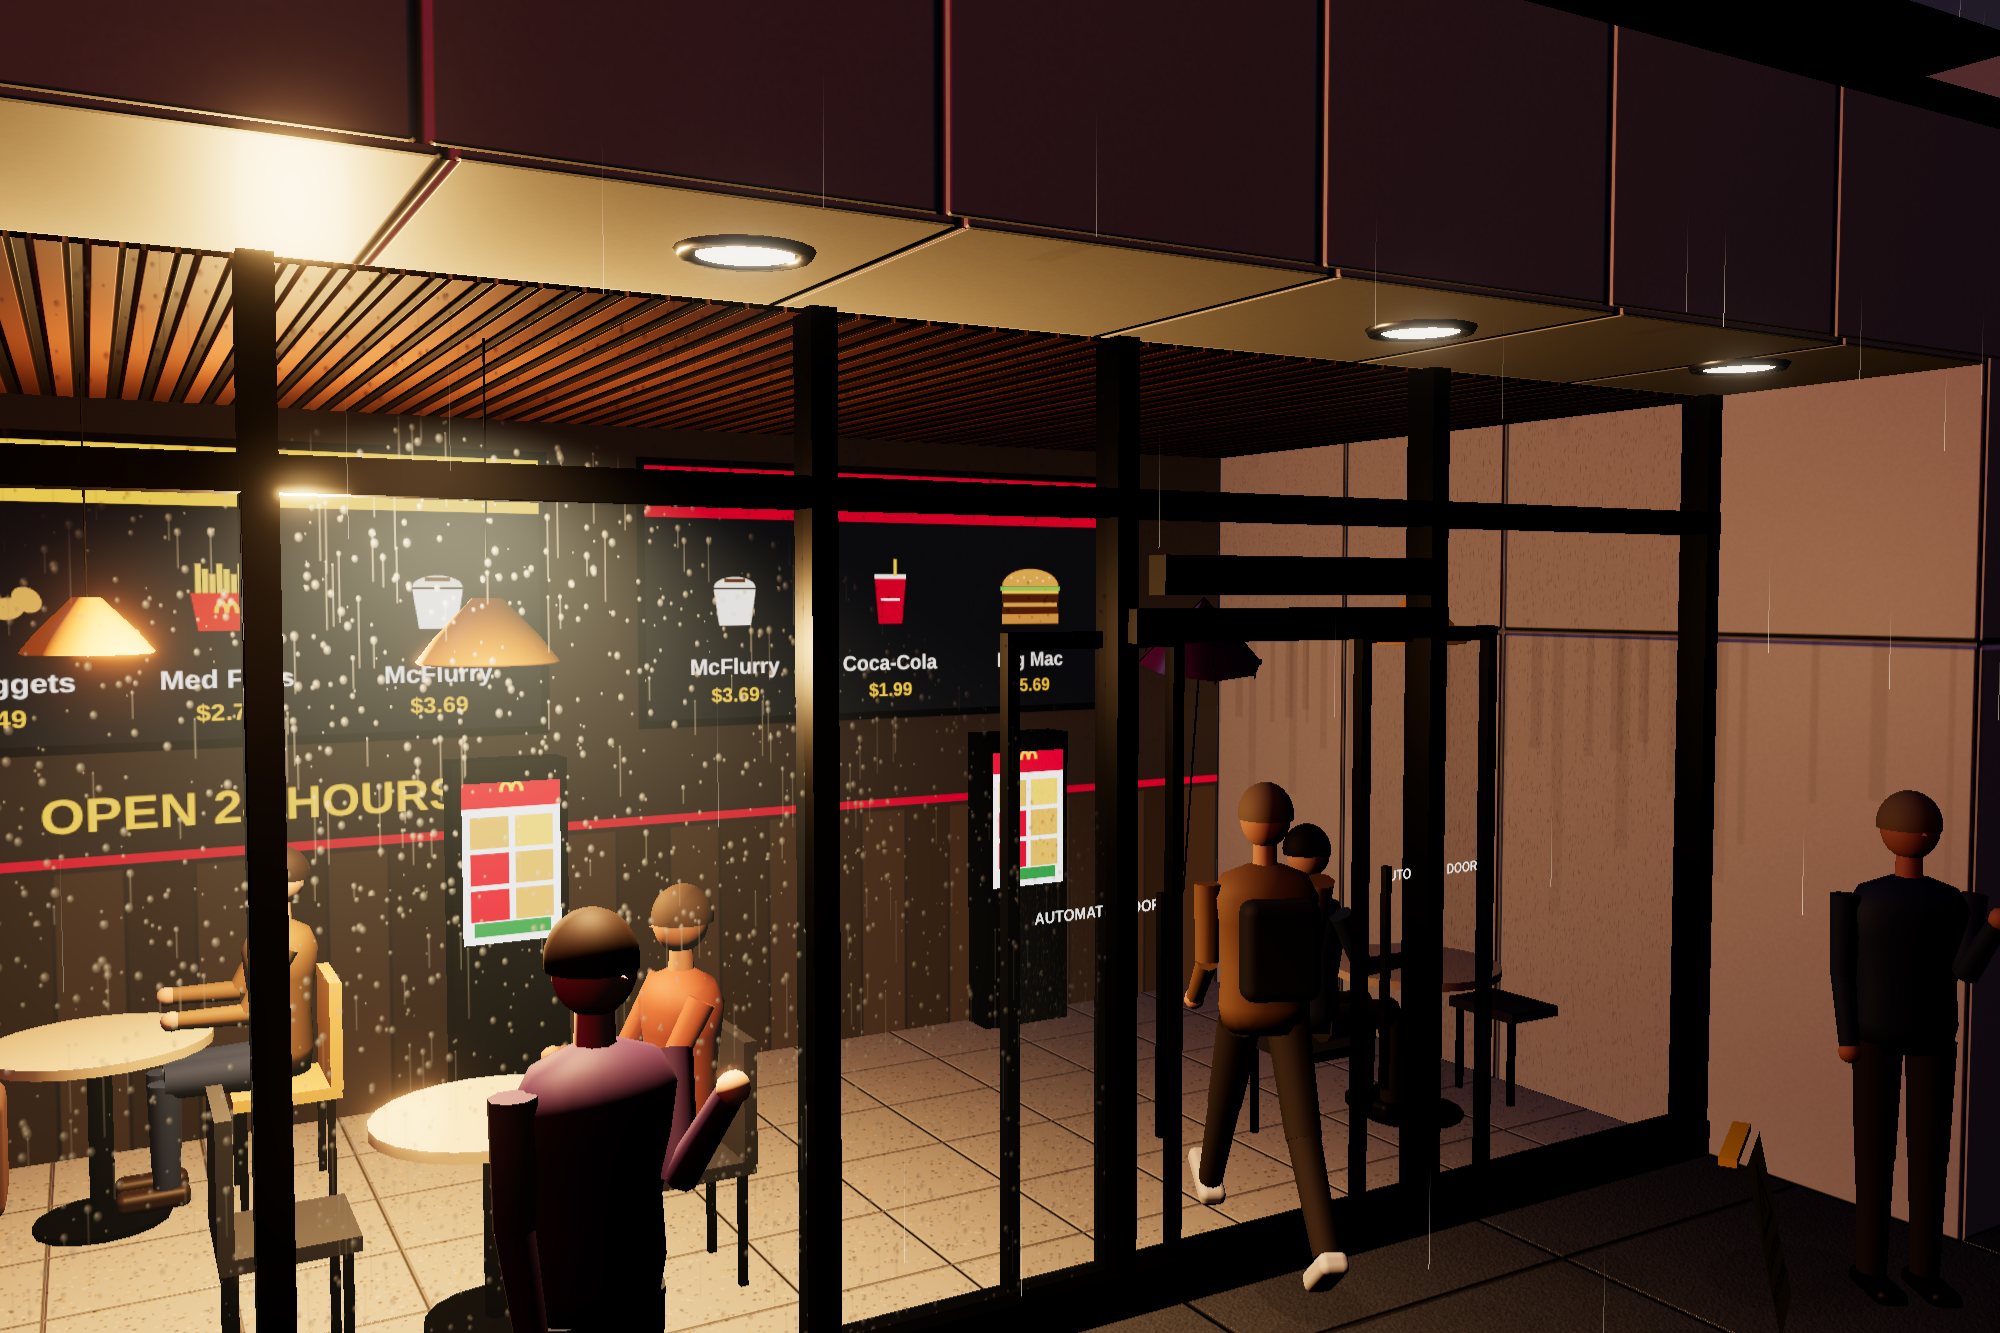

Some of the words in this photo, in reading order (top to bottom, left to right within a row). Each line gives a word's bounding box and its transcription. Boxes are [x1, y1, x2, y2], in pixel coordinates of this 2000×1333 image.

[690, 657, 780, 679] McFlurry
[843, 653, 938, 671] Coca-Cola
[1030, 651, 1063, 667] Mac
[160, 669, 218, 691] Med
[385, 665, 493, 686] McFlurry
[1020, 677, 1050, 692] 5.69
[712, 687, 760, 704] $3.69
[869, 681, 913, 698] $1.99
[196, 703, 243, 723] $2.7
[410, 696, 469, 715] $3.69
[41, 792, 197, 835] OPEN
[214, 790, 244, 824] 2
[1446, 860, 1478, 874] DOOR
[1035, 904, 1104, 926] AUTOMAT
